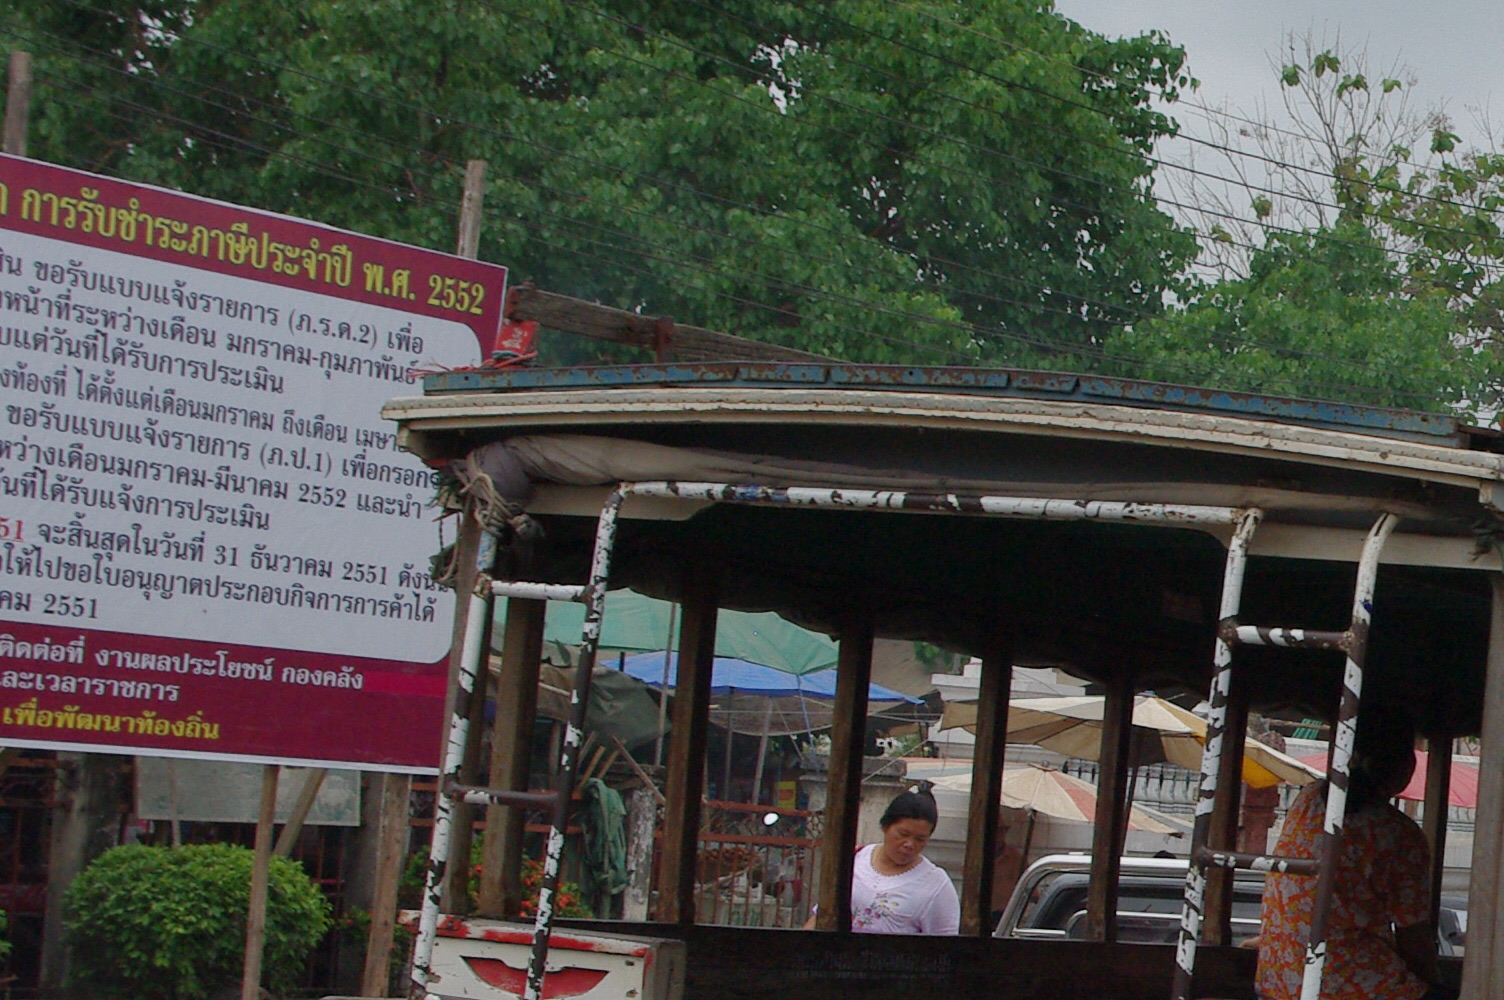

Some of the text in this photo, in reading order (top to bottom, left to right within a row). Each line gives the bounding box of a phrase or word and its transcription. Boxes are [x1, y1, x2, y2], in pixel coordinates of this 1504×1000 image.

[21, 186, 352, 287] การรับชำระภาษีประจำปี
[362, 262, 416, 301] พ.ศ.
[427, 273, 485, 316] 2552
[0, 286, 217, 349] หน้าที่ระหว่างเดือน
[33, 259, 279, 326] ขอรับแบบแจ้งรายการ
[387, 322, 424, 355] เพื่อ
[6, 401, 250, 461] ขอรับแบบแจ้งรายการ
[73, 365, 274, 431] ได้ตั้งแต่เดือนมกราคม
[282, 408, 348, 443] ถึงเดือน
[298, 483, 347, 508] 2552
[357, 493, 421, 519] และนำ
[38, 511, 206, 563] จะสิ้นสุดในวันที่
[214, 545, 239, 567] 31
[250, 543, 333, 578] ธันวาคม
[342, 561, 388, 586] 2551
[43, 593, 98, 619] 2551
[0, 669, 180, 701] ละเวลาราชการ
[95, 649, 275, 682] งานผลประโยชน์
[281, 665, 364, 690] กองคลัง
[3, 696, 220, 740] เพื่อพัฒนาท้องถิ่น
